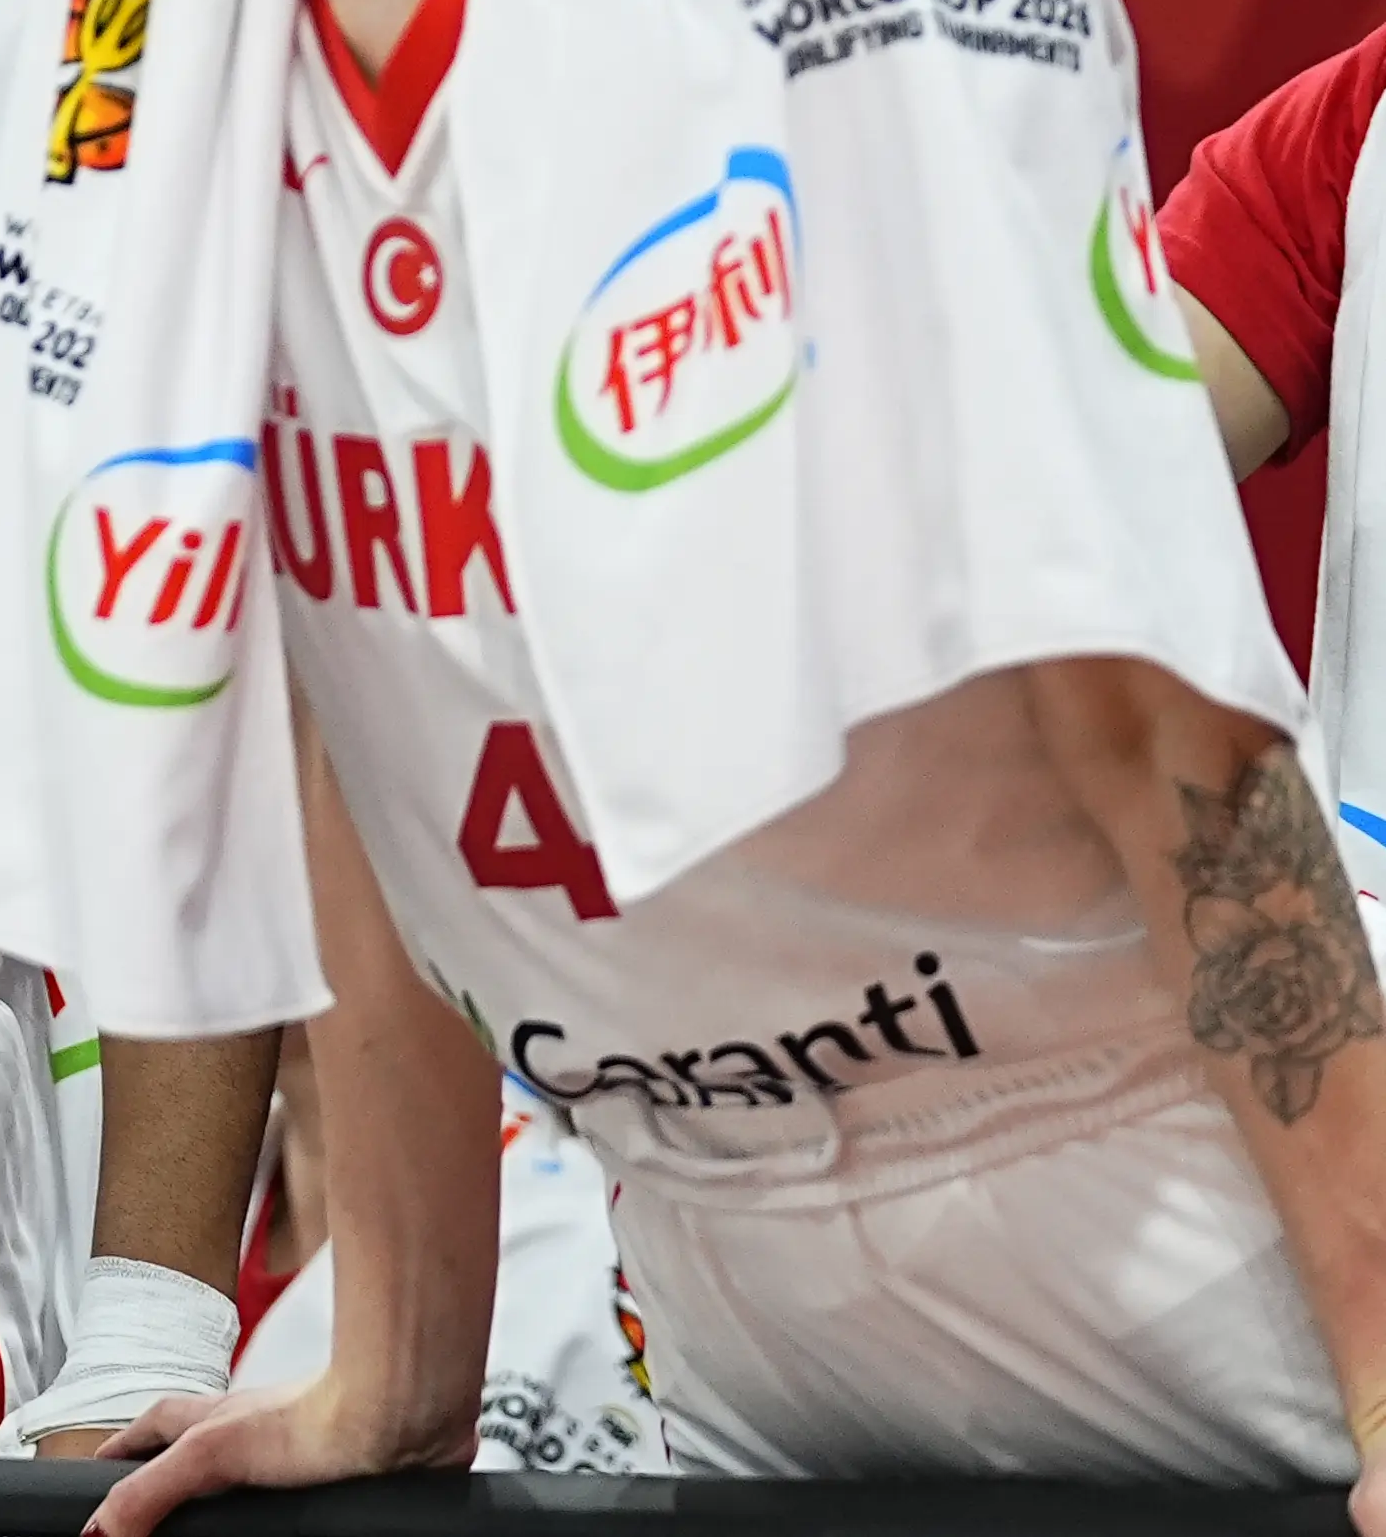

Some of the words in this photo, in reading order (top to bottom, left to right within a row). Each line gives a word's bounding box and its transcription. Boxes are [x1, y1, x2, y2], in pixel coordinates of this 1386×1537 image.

[31, 319, 97, 371] 202
[599, 206, 793, 433] 伊利
[259, 385, 519, 619] ÜRK
[457, 720, 623, 922] 4
